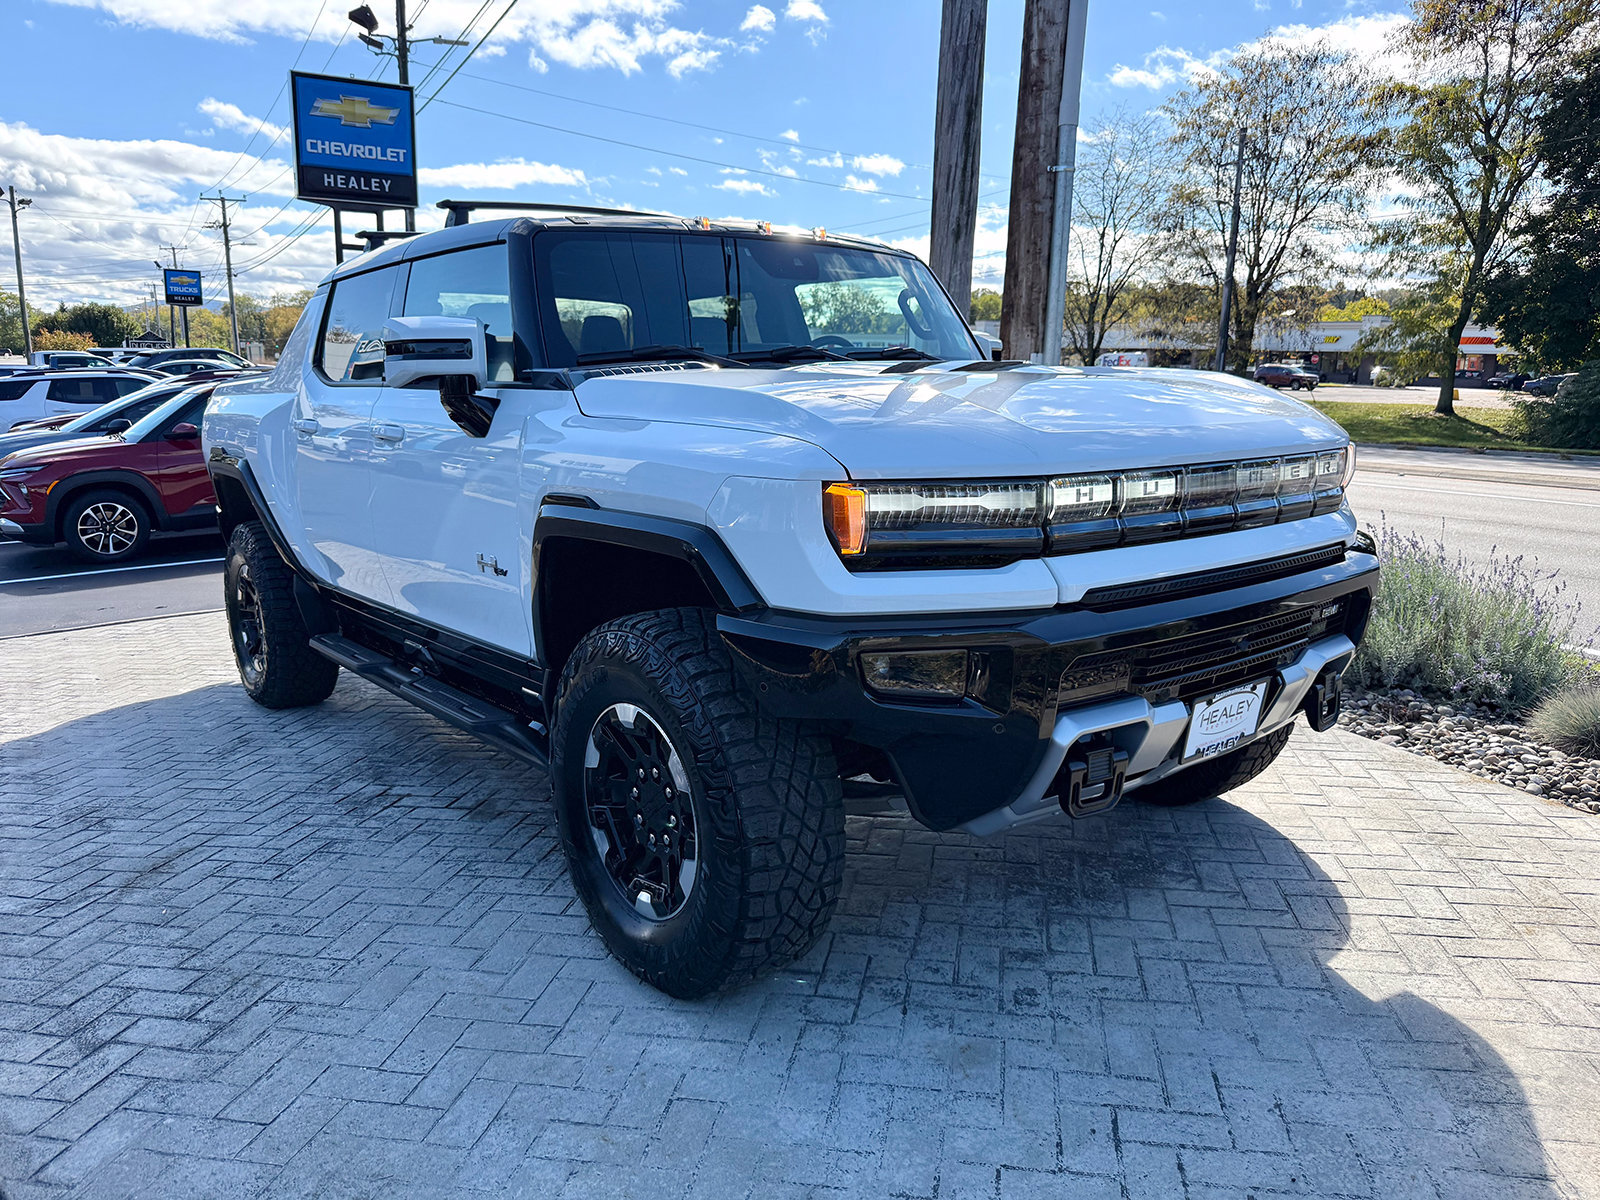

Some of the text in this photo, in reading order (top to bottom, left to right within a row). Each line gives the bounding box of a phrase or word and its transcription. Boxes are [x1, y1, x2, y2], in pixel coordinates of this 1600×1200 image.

[306, 138, 407, 162] CHEVROLET
[323, 173, 392, 192] HEALEY
[169, 286, 198, 294] TRUCKS
[1101, 355, 1132, 367] FedEx
[1199, 697, 1256, 728] HEALEY
[1202, 736, 1240, 757] HEALEY
